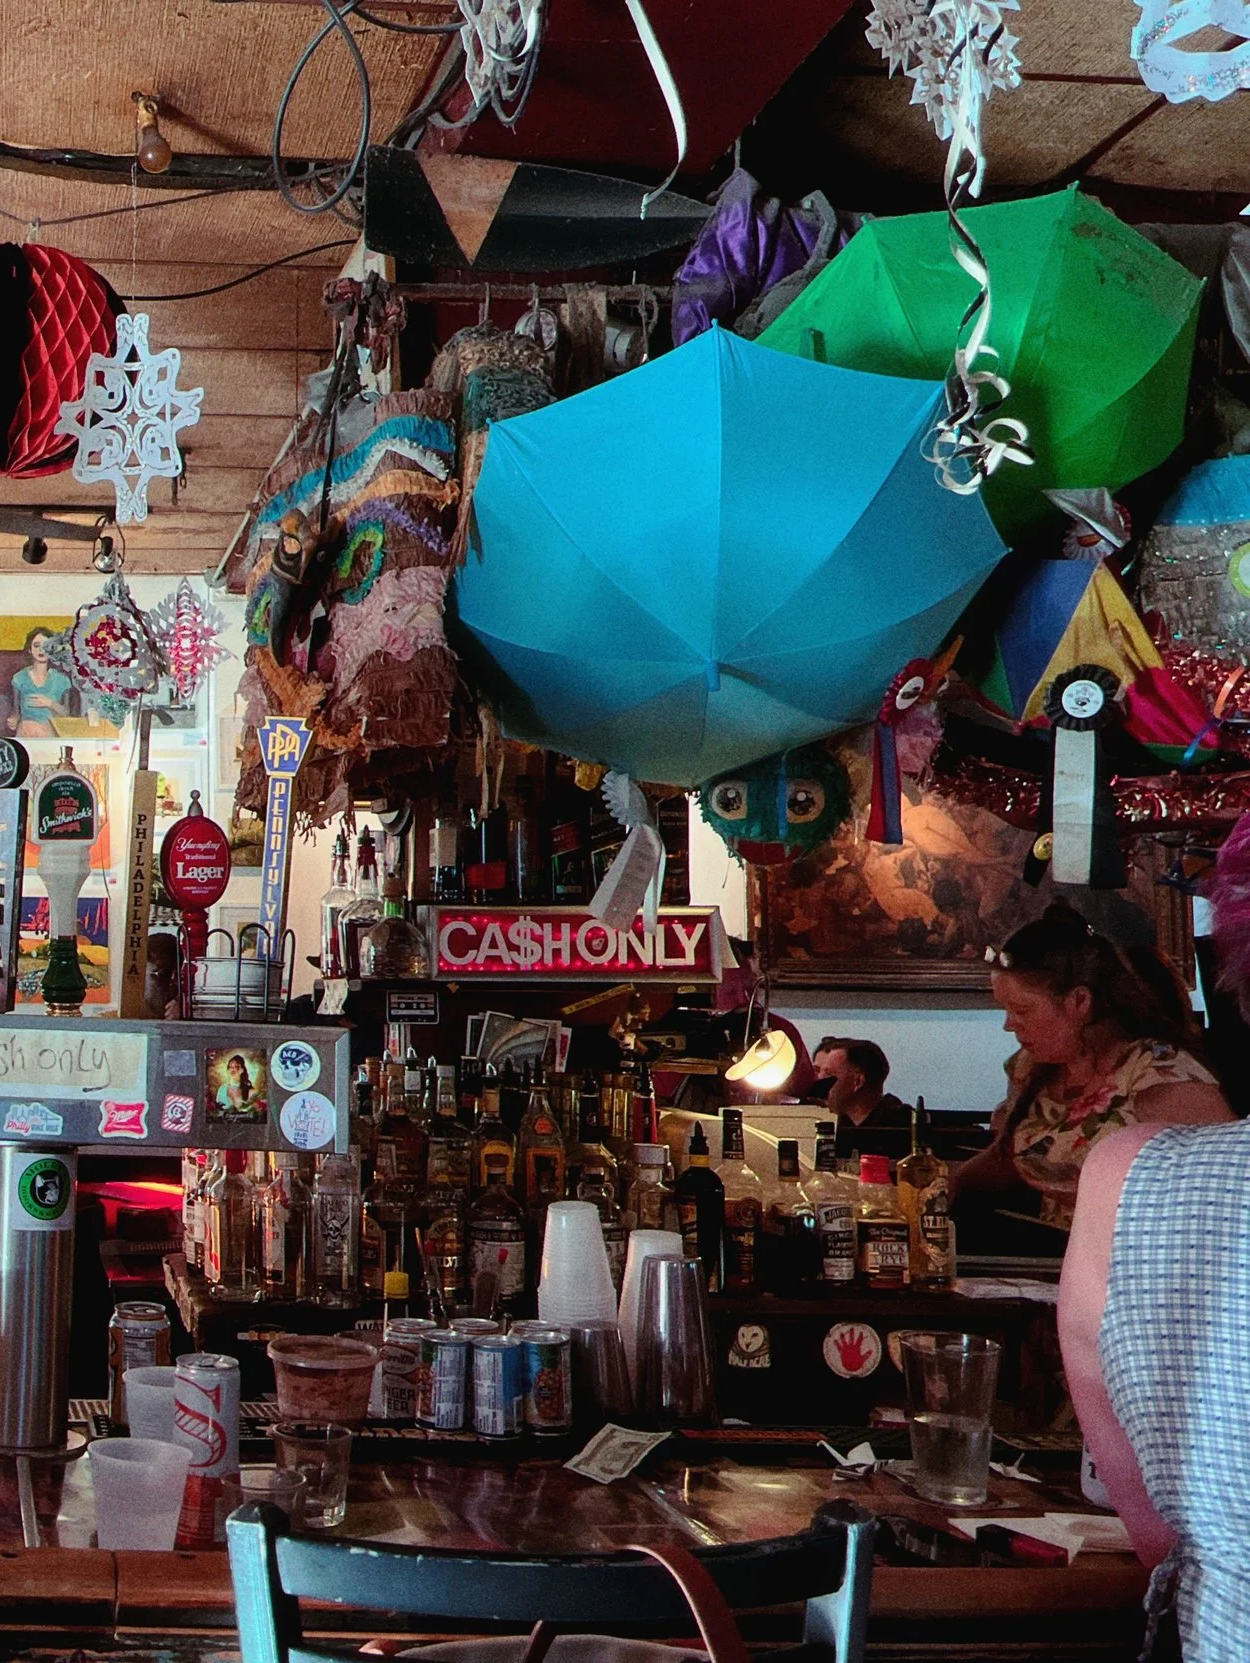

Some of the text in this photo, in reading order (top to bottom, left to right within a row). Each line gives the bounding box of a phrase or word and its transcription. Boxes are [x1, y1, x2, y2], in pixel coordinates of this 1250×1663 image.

[39, 807, 92, 834] Smithwick's
[175, 837, 221, 852] Yuengling
[176, 862, 224, 883] Lager
[126, 814, 148, 976] PHILADELPHIA
[439, 916, 707, 970] CA$H ONLY
[38, 1042, 112, 1092] only
[6, 1120, 31, 1133] Philly
[872, 1243, 906, 1253] ROCK
